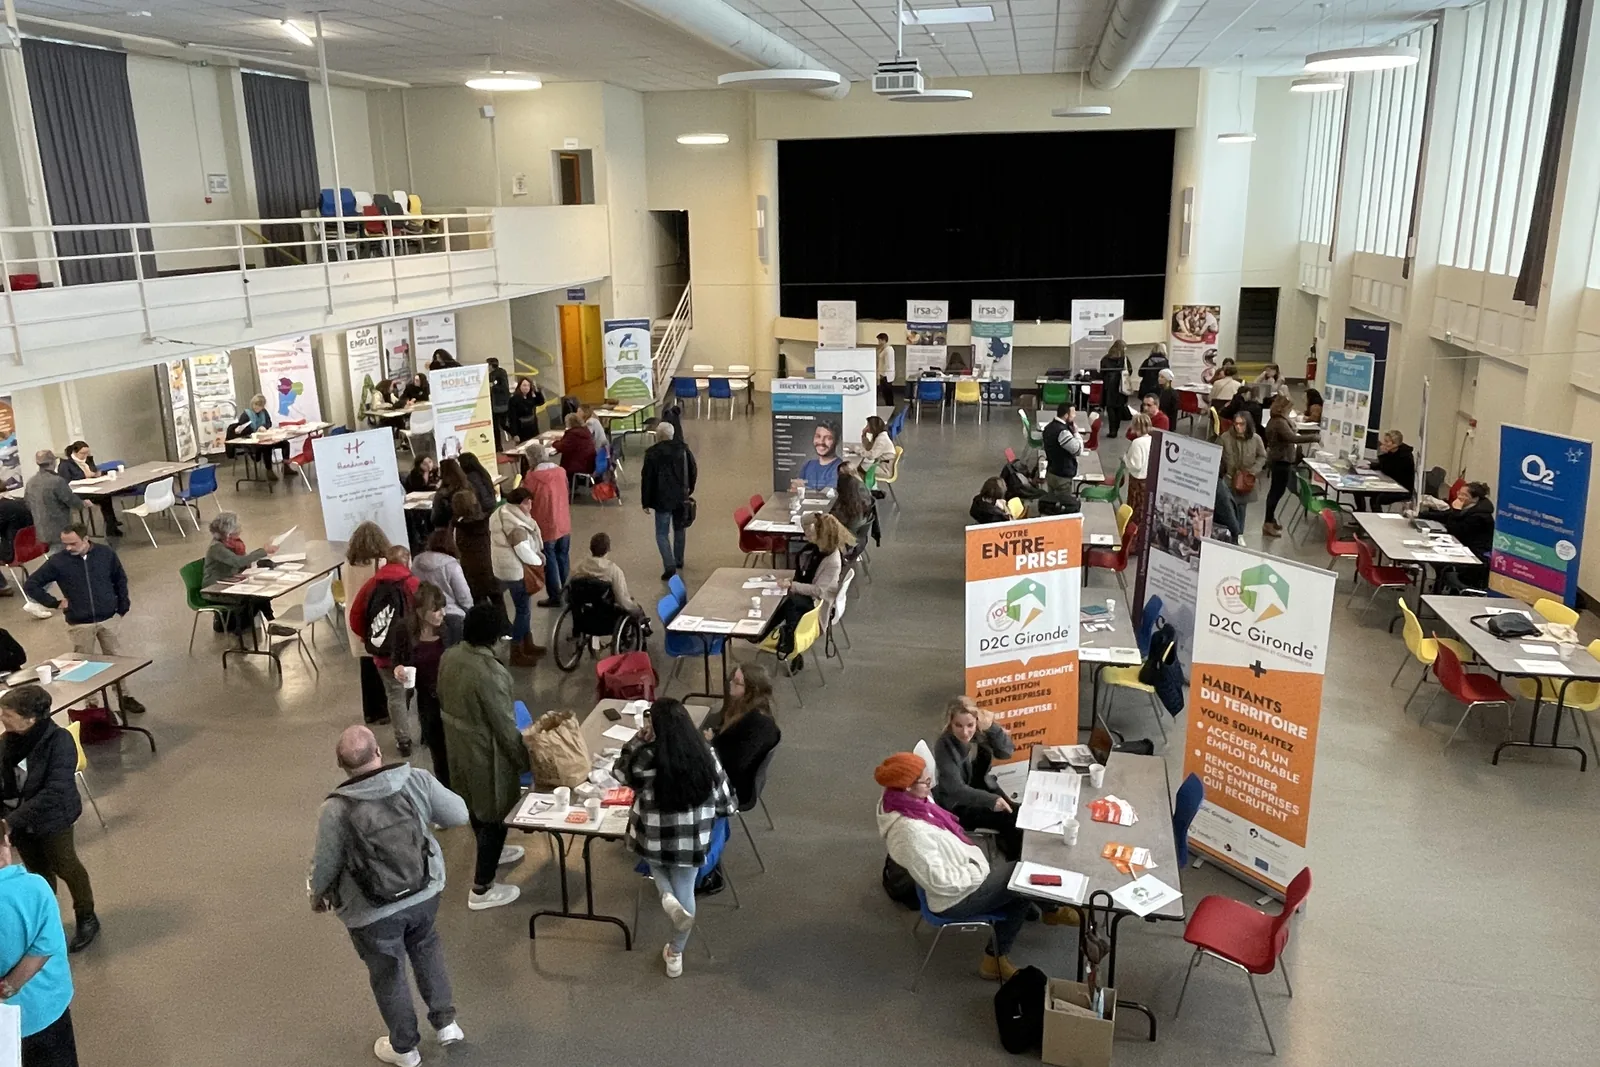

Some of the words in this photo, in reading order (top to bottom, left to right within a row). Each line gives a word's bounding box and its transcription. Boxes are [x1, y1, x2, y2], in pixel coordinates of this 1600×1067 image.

[913, 304, 931, 315] irsa
[978, 304, 997, 315] irsa
[350, 336, 378, 349] EMPLOI
[355, 329, 371, 339] CAP
[999, 529, 1028, 540] VOTRE
[1015, 549, 1068, 571] PRISE
[980, 635, 1009, 652] D2C
[1015, 626, 1069, 645] Gironde
[1209, 613, 1242, 635] D2C
[1247, 626, 1314, 660] Gironde
[976, 675, 1012, 689] SERVICE
[1014, 672, 1027, 681] DE
[1028, 663, 1074, 679] PROXIMITÉ
[984, 681, 1041, 697] DISPOSITION
[995, 688, 1052, 705] ENTREPRISES
[1202, 673, 1283, 714] HABITANTS
[1007, 703, 1053, 719] EXPERTISE
[1200, 687, 1220, 704] DU
[1223, 695, 1308, 740] TERRITOIRE
[1200, 707, 1230, 725] VOUS
[1232, 720, 1296, 753] SOUHAITEZ
[1207, 725, 1258, 753] ACCÉDER
[1260, 744, 1268, 758] À
[1271, 751, 1289, 767] UN
[1205, 752, 1278, 793] RENCONTRER
[1206, 736, 1246, 760] EMPLOI
[1248, 754, 1301, 784] DURABLE
[1203, 776, 1222, 791] QUI
[1225, 786, 1289, 823] RECRUTENT
[1204, 764, 1225, 780] DES
[1227, 775, 1300, 816] ENTREPRISES
